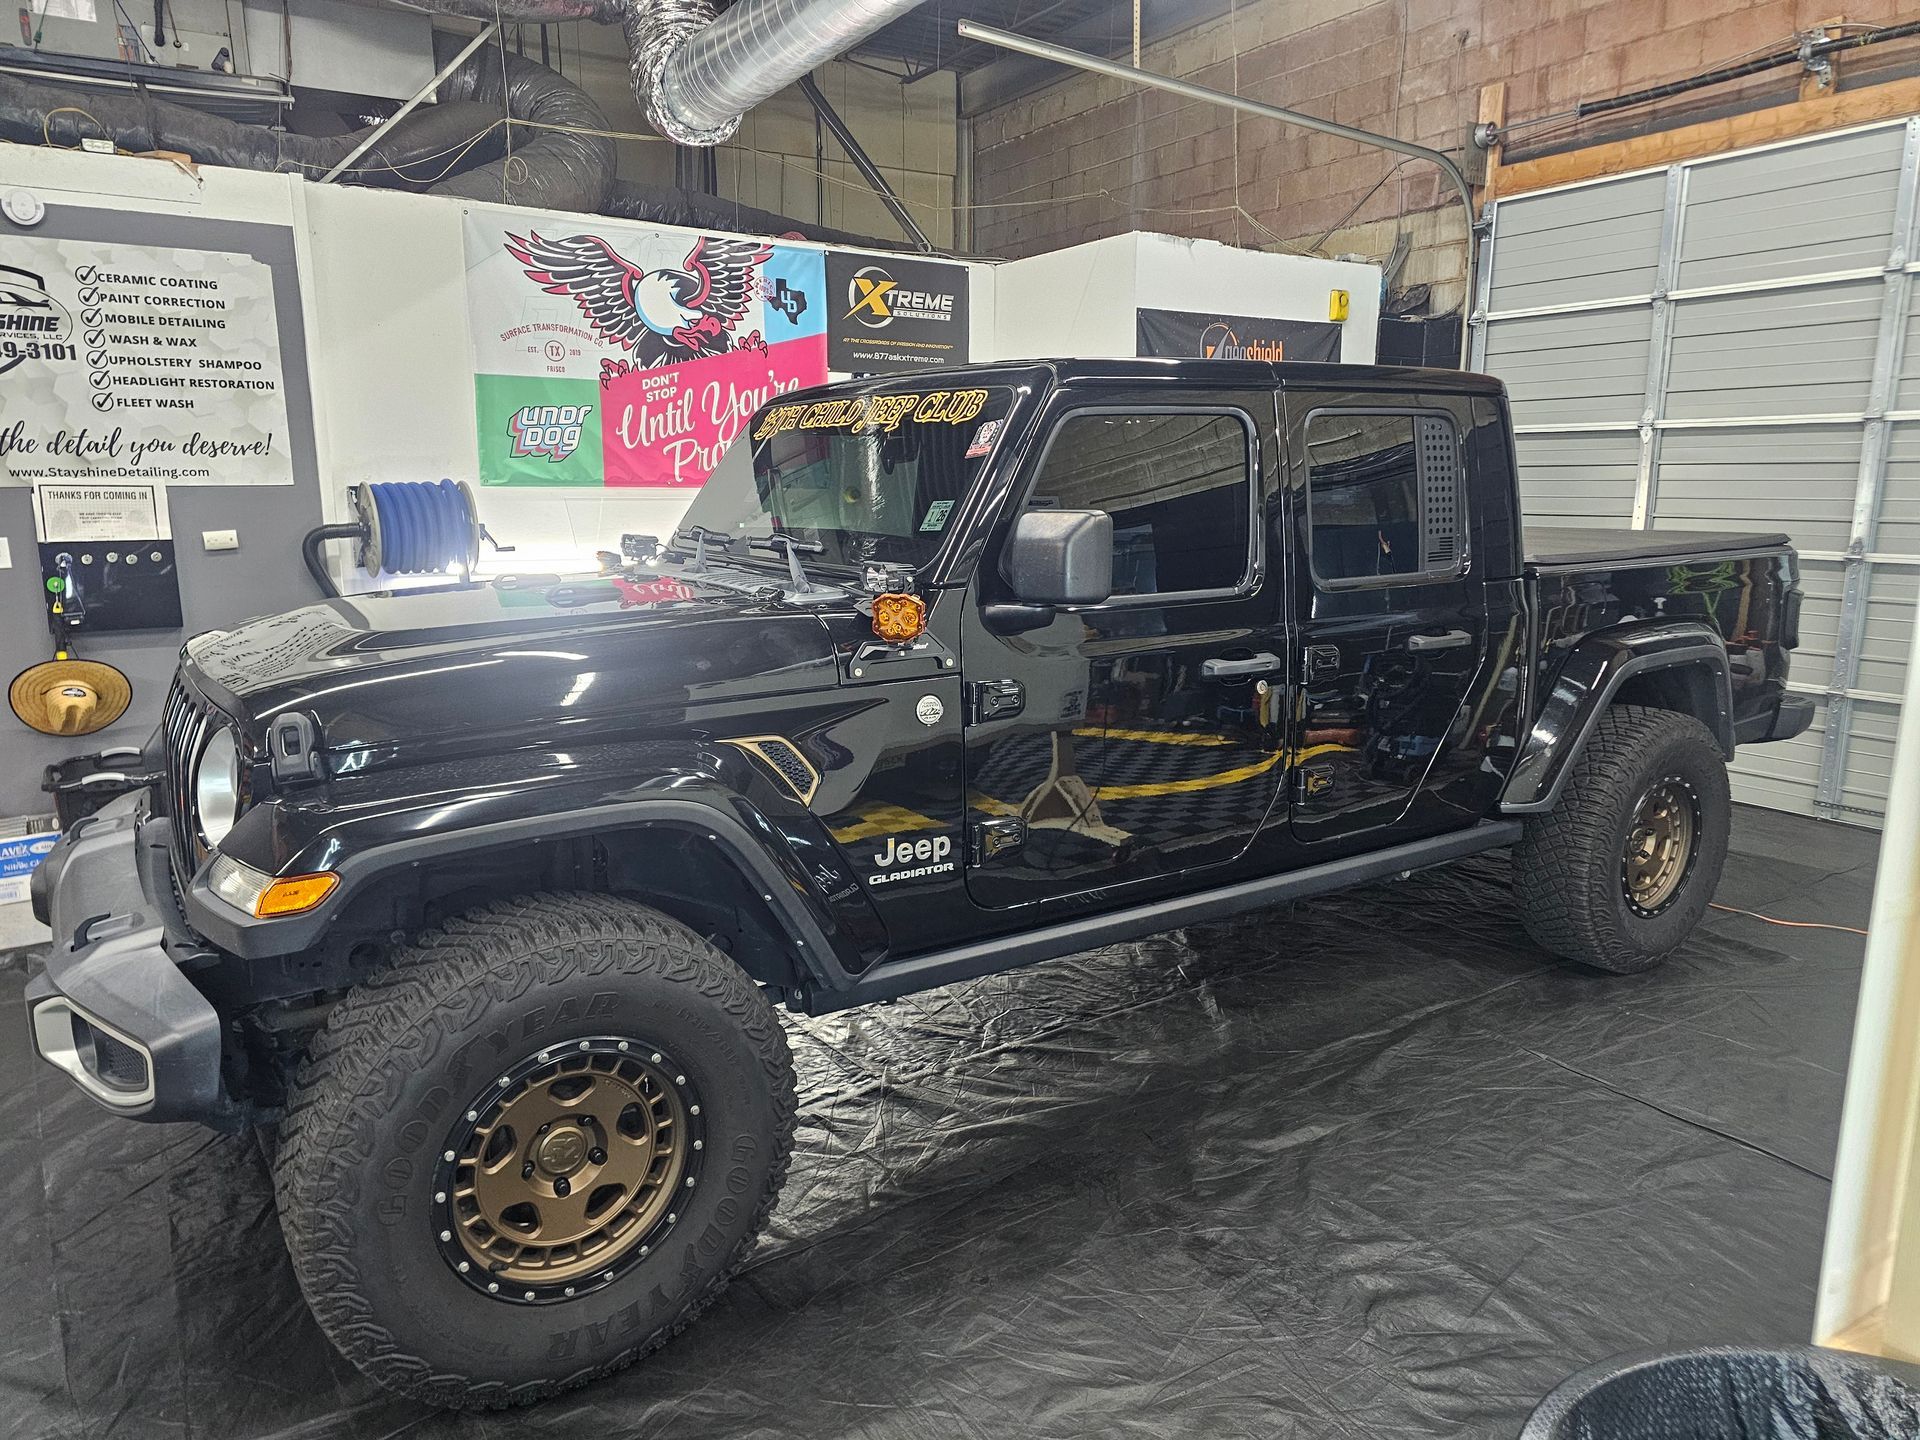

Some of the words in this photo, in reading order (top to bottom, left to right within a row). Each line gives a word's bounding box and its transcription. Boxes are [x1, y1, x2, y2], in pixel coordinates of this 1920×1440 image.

[97, 273, 156, 286] CERAMIC
[160, 277, 218, 290] COATING
[100, 293, 140, 304] PAINT
[144, 296, 225, 309] CORRECTION
[842, 277, 954, 319] XTREME
[104, 314, 155, 325] MOBILE
[158, 316, 226, 329] DETAILING
[896, 311, 948, 320] SOLUTIONS
[109, 334, 149, 345] WASH
[152, 336, 162, 346] &
[165, 337, 197, 347] WAX
[500, 325, 531, 342] SURFACE
[532, 323, 593, 341] TRANSFORMATION
[0, 341, 77, 360] 9-3101
[549, 345, 560, 357] TX
[853, 352, 945, 364] www.877askxtreme.com
[109, 355, 192, 368] UPHOLSTERY
[198, 359, 262, 370] SHAMPOO
[546, 365, 565, 373] FRISCO
[189, 379, 275, 390] RESTORATION
[642, 372, 679, 390] DON'T
[646, 387, 678, 403] STOP
[117, 398, 152, 408] FLEET
[155, 399, 194, 409] WASH
[852, 394, 920, 433] JEEP
[913, 389, 988, 424] CLUB
[616, 388, 695, 449] Until
[0, 420, 40, 457] the
[46, 427, 123, 457] detail
[129, 437, 177, 466] you
[182, 432, 273, 458] deserve!
[663, 439, 731, 482] Pro
[9, 467, 210, 479] www.StayshineDetailing.com
[48, 491, 81, 500] THANKS
[84, 491, 101, 500] FOR
[103, 491, 137, 500] COMING
[138, 491, 147, 500] IN
[874, 835, 951, 867] Jeep
[868, 862, 954, 885] GLADIATOR
